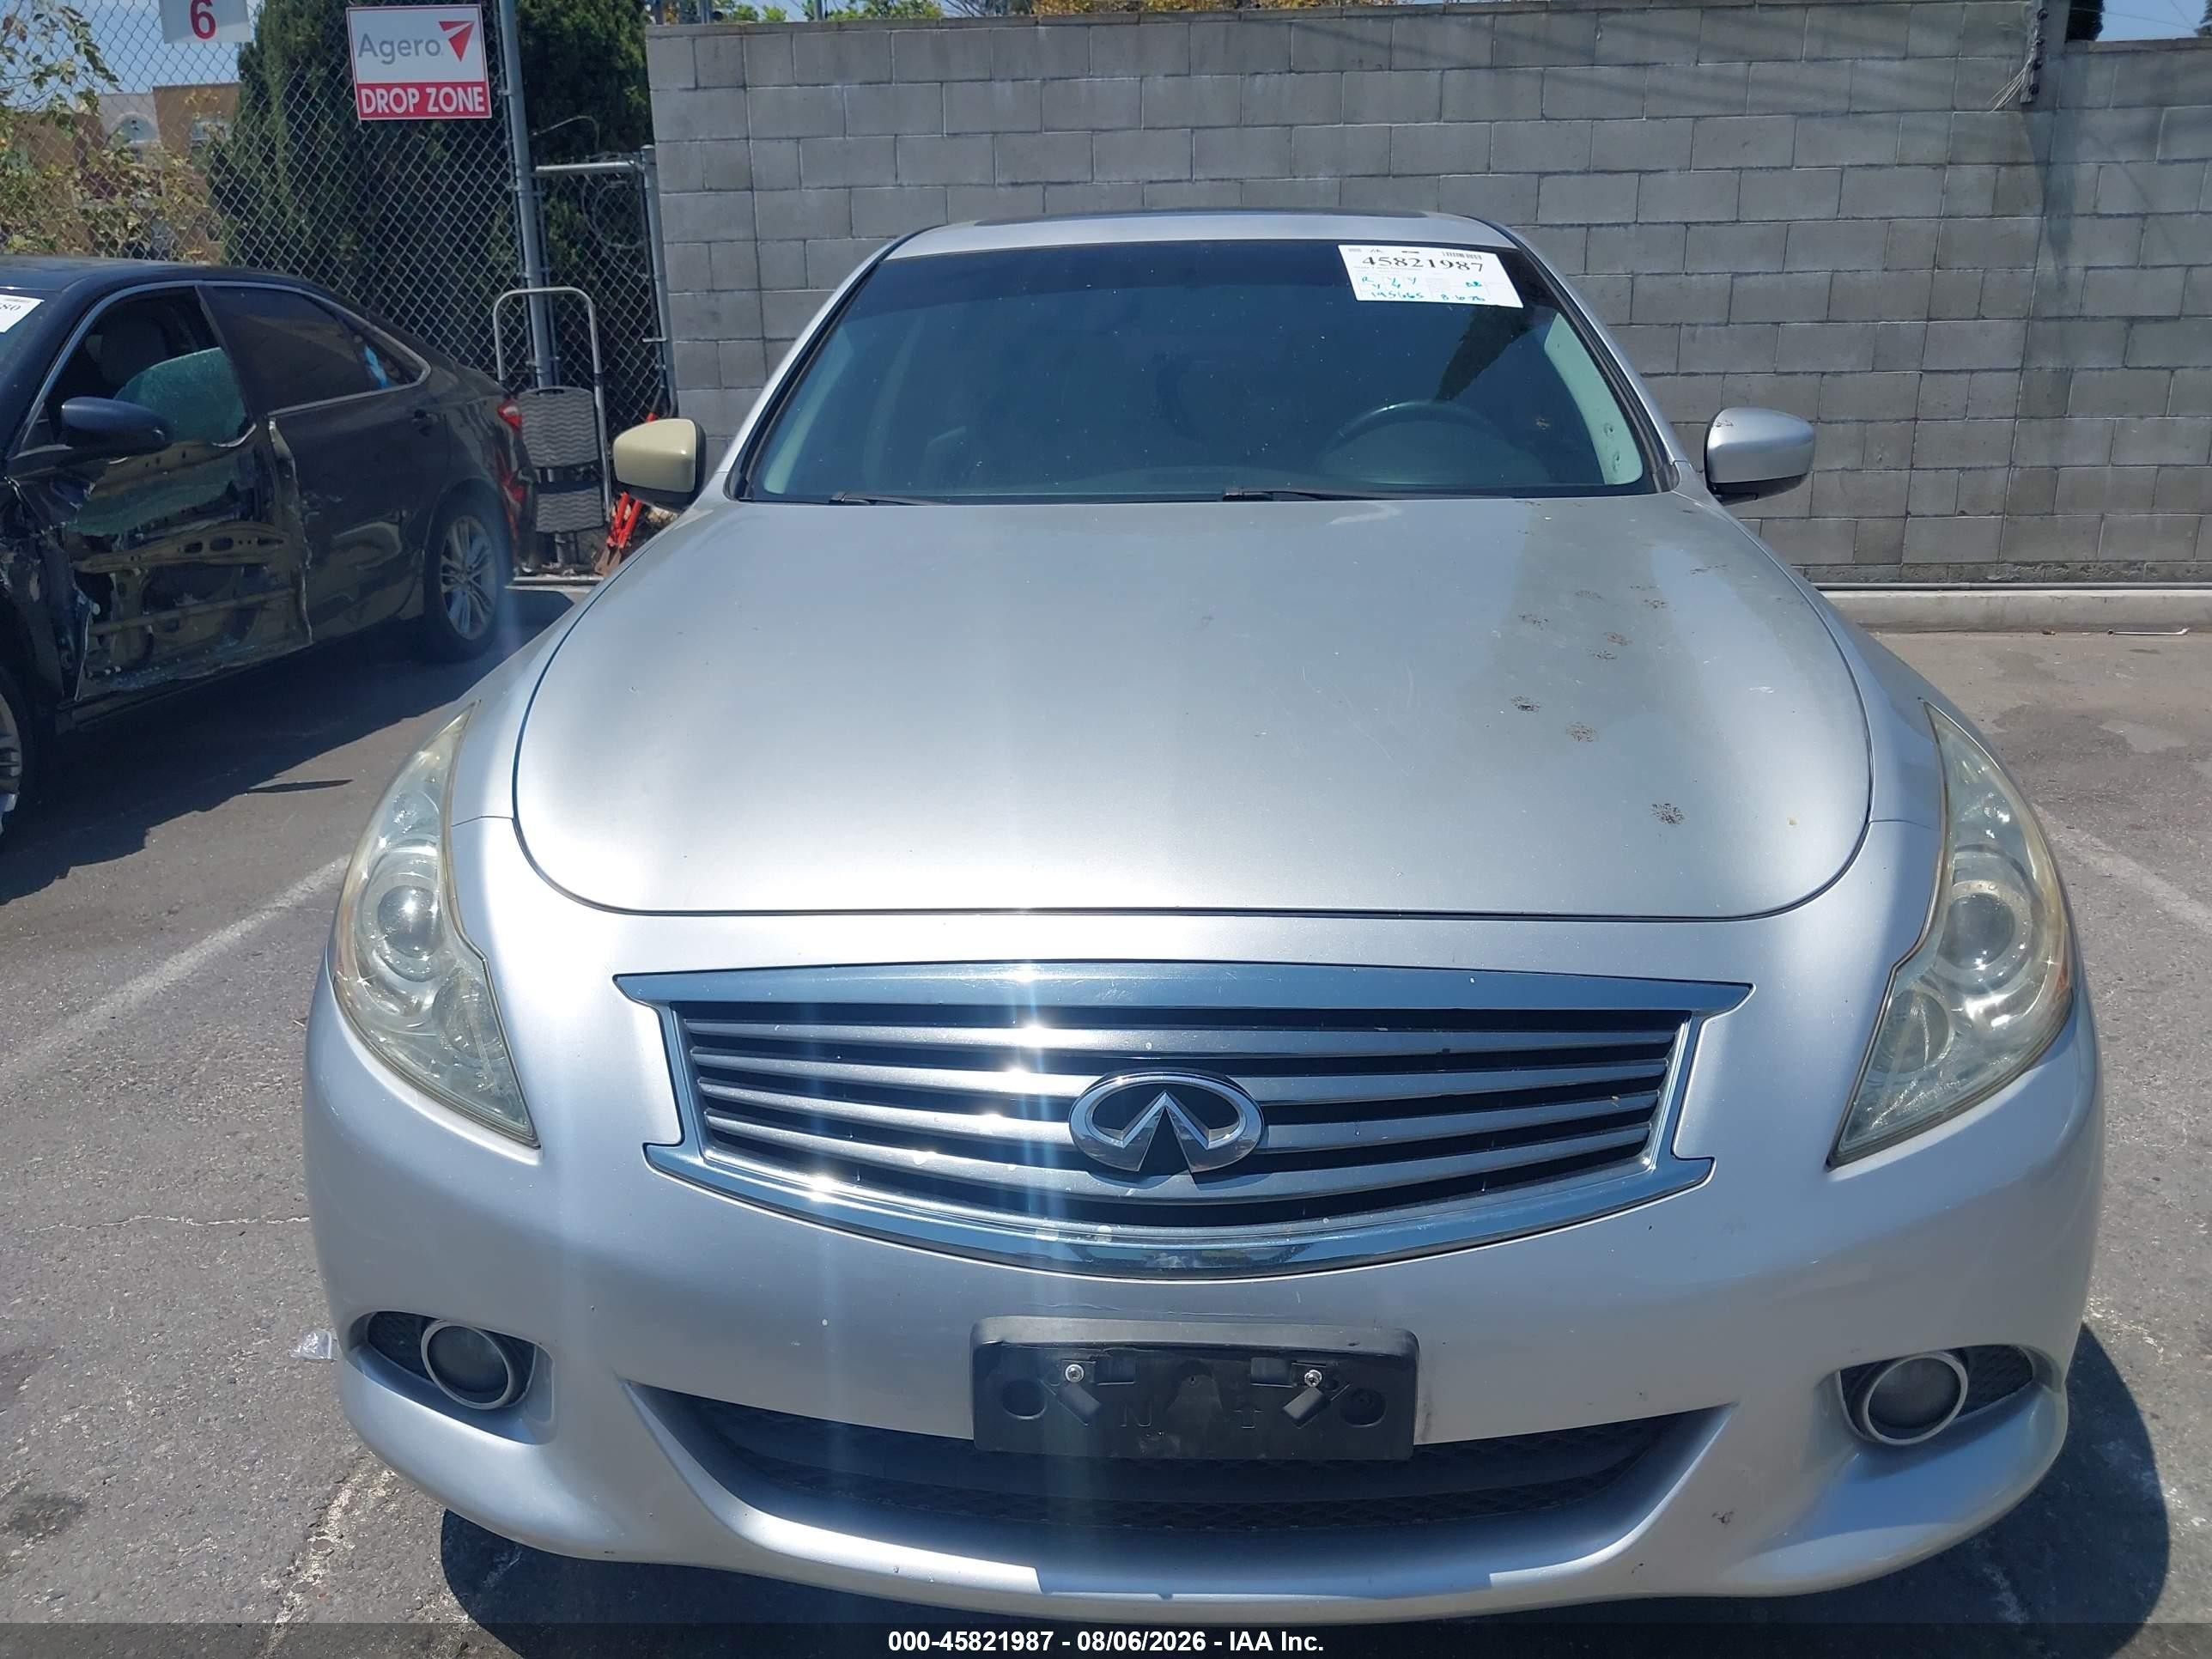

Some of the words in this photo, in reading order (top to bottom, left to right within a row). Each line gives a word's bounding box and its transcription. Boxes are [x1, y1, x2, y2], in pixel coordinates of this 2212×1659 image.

[190, 0, 216, 40] 6
[358, 33, 441, 64] Agero
[361, 87, 420, 113] DROP
[425, 87, 485, 112] ZONE
[1362, 256, 1483, 272] 45821987
